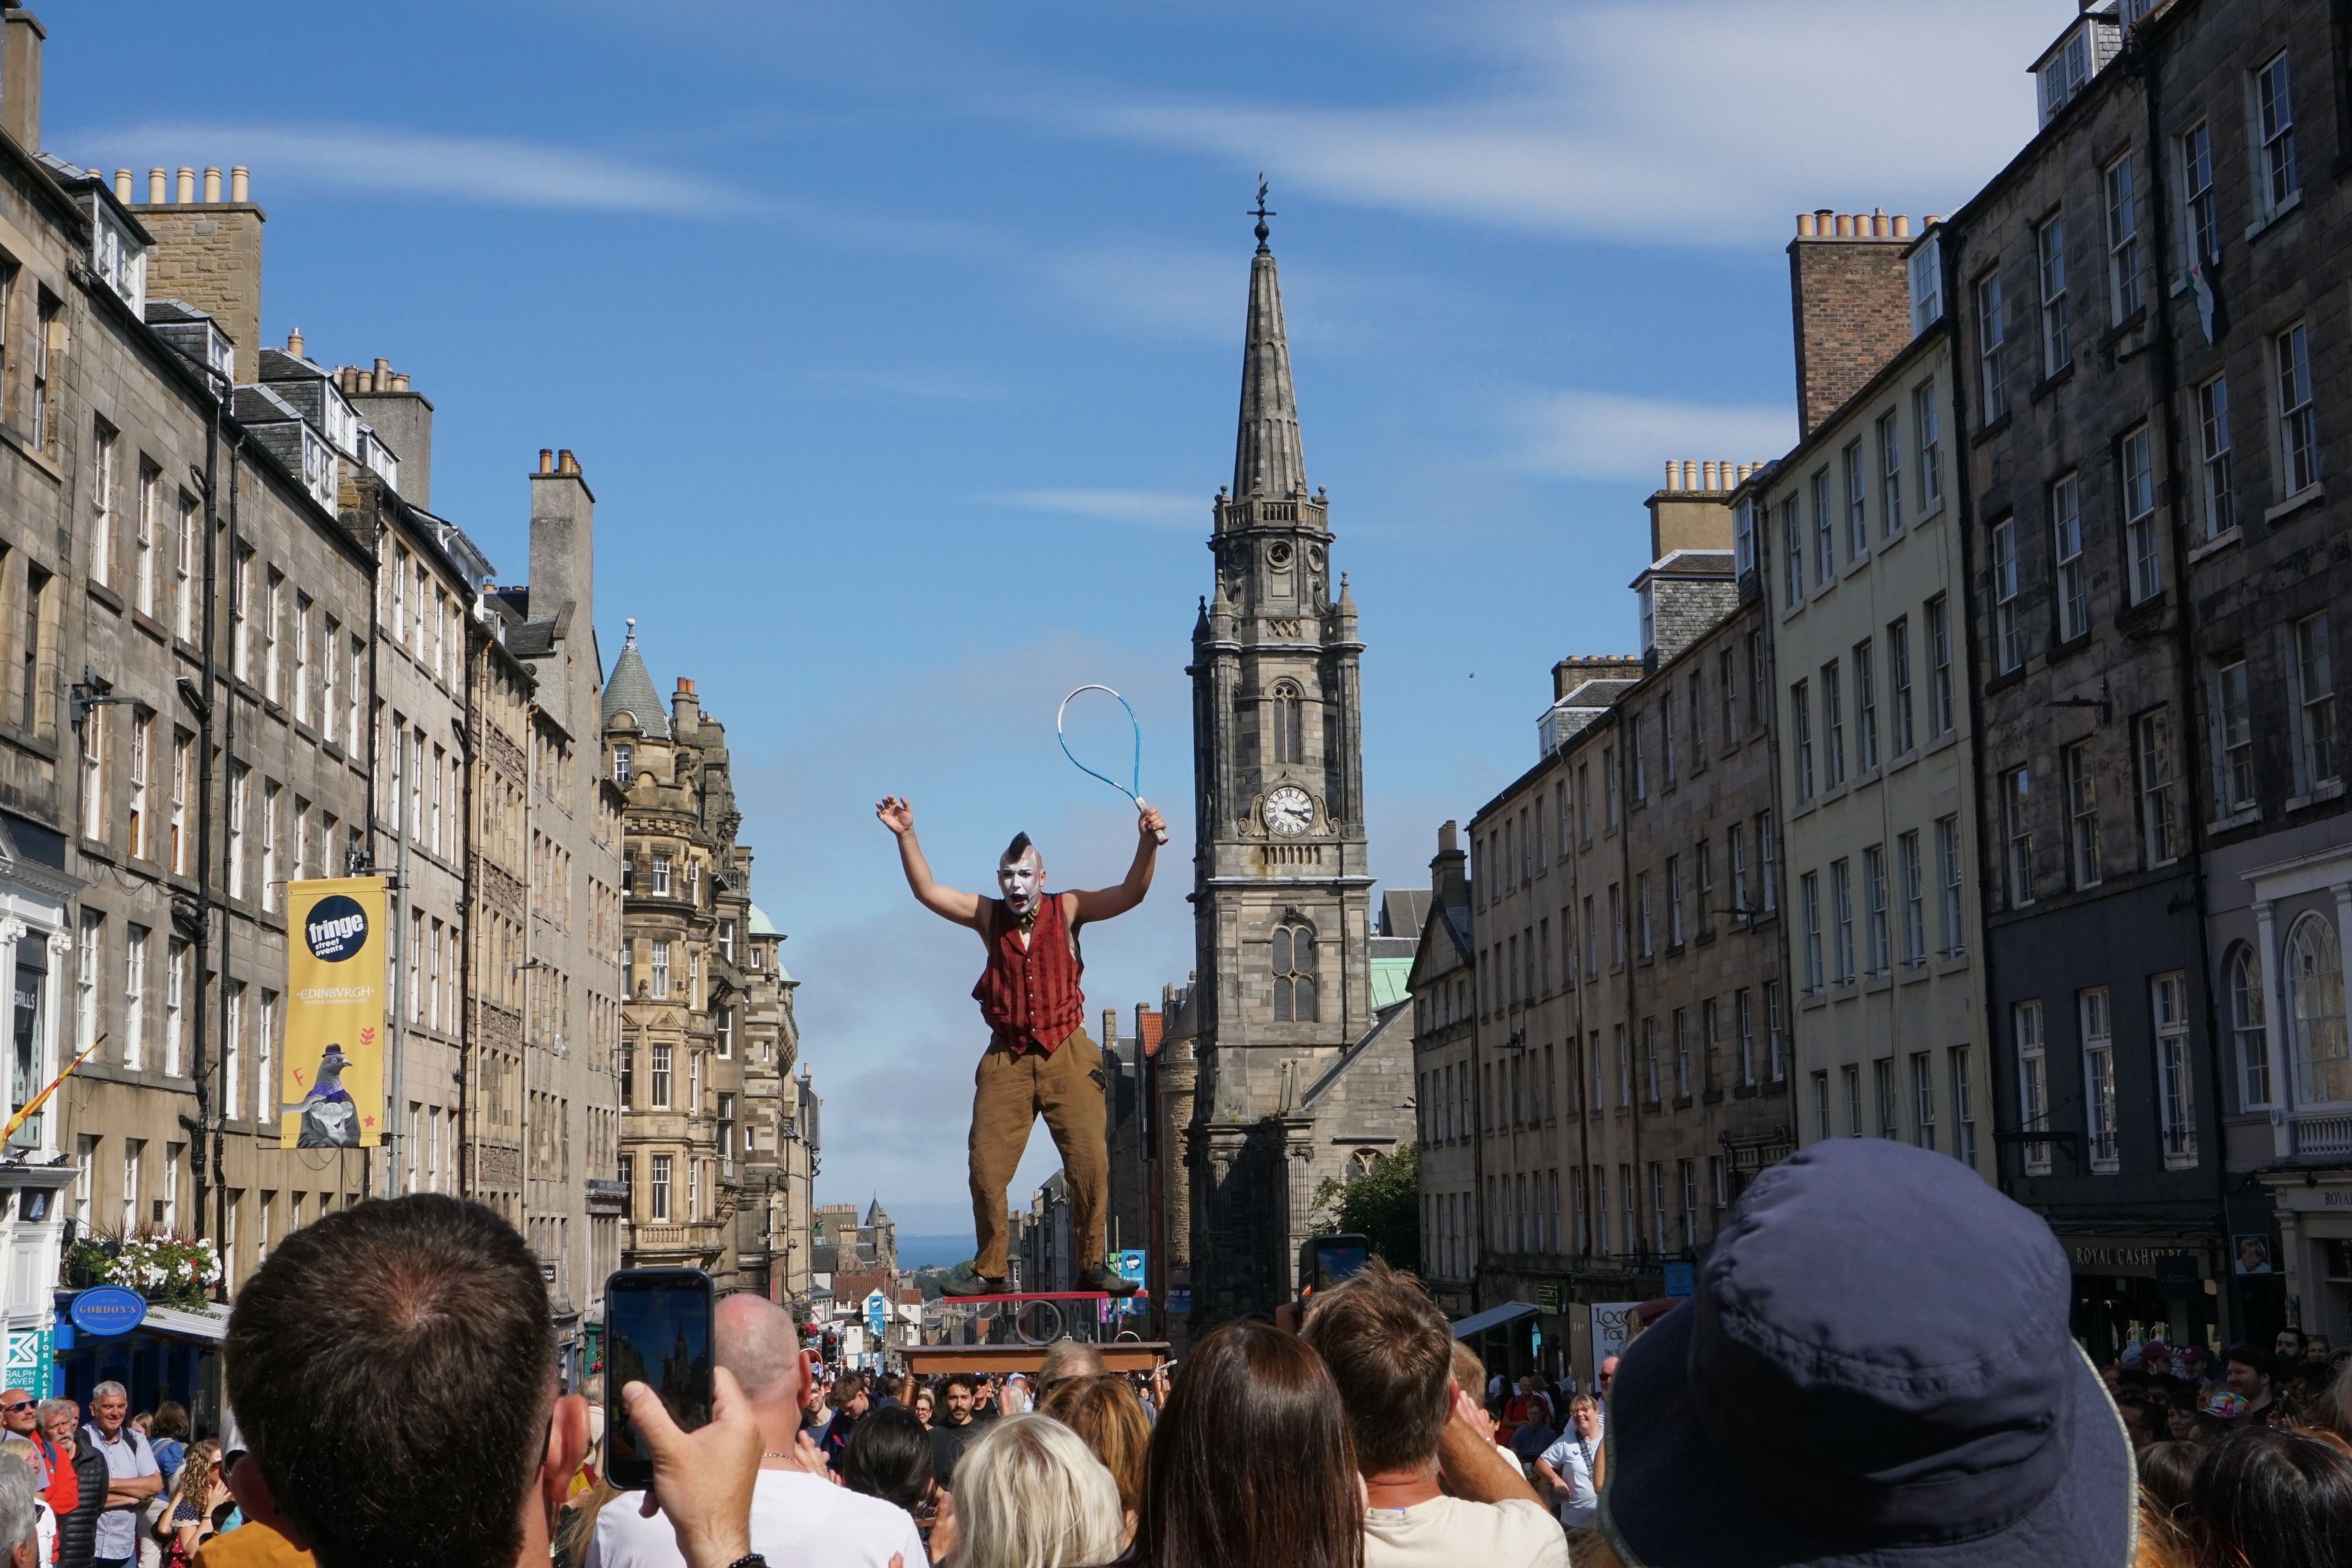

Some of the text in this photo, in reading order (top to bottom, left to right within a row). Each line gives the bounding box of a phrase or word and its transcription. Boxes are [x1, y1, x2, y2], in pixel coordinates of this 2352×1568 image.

[309, 914, 364, 943] fringe
[315, 938, 340, 950] street
[315, 945, 344, 956] events
[15, 990, 35, 1010] GRILLS
[2076, 1248, 2112, 1265] ROYAL
[79, 1306, 136, 1314] GORDON'S
[1603, 1329, 1623, 1340] FOR
